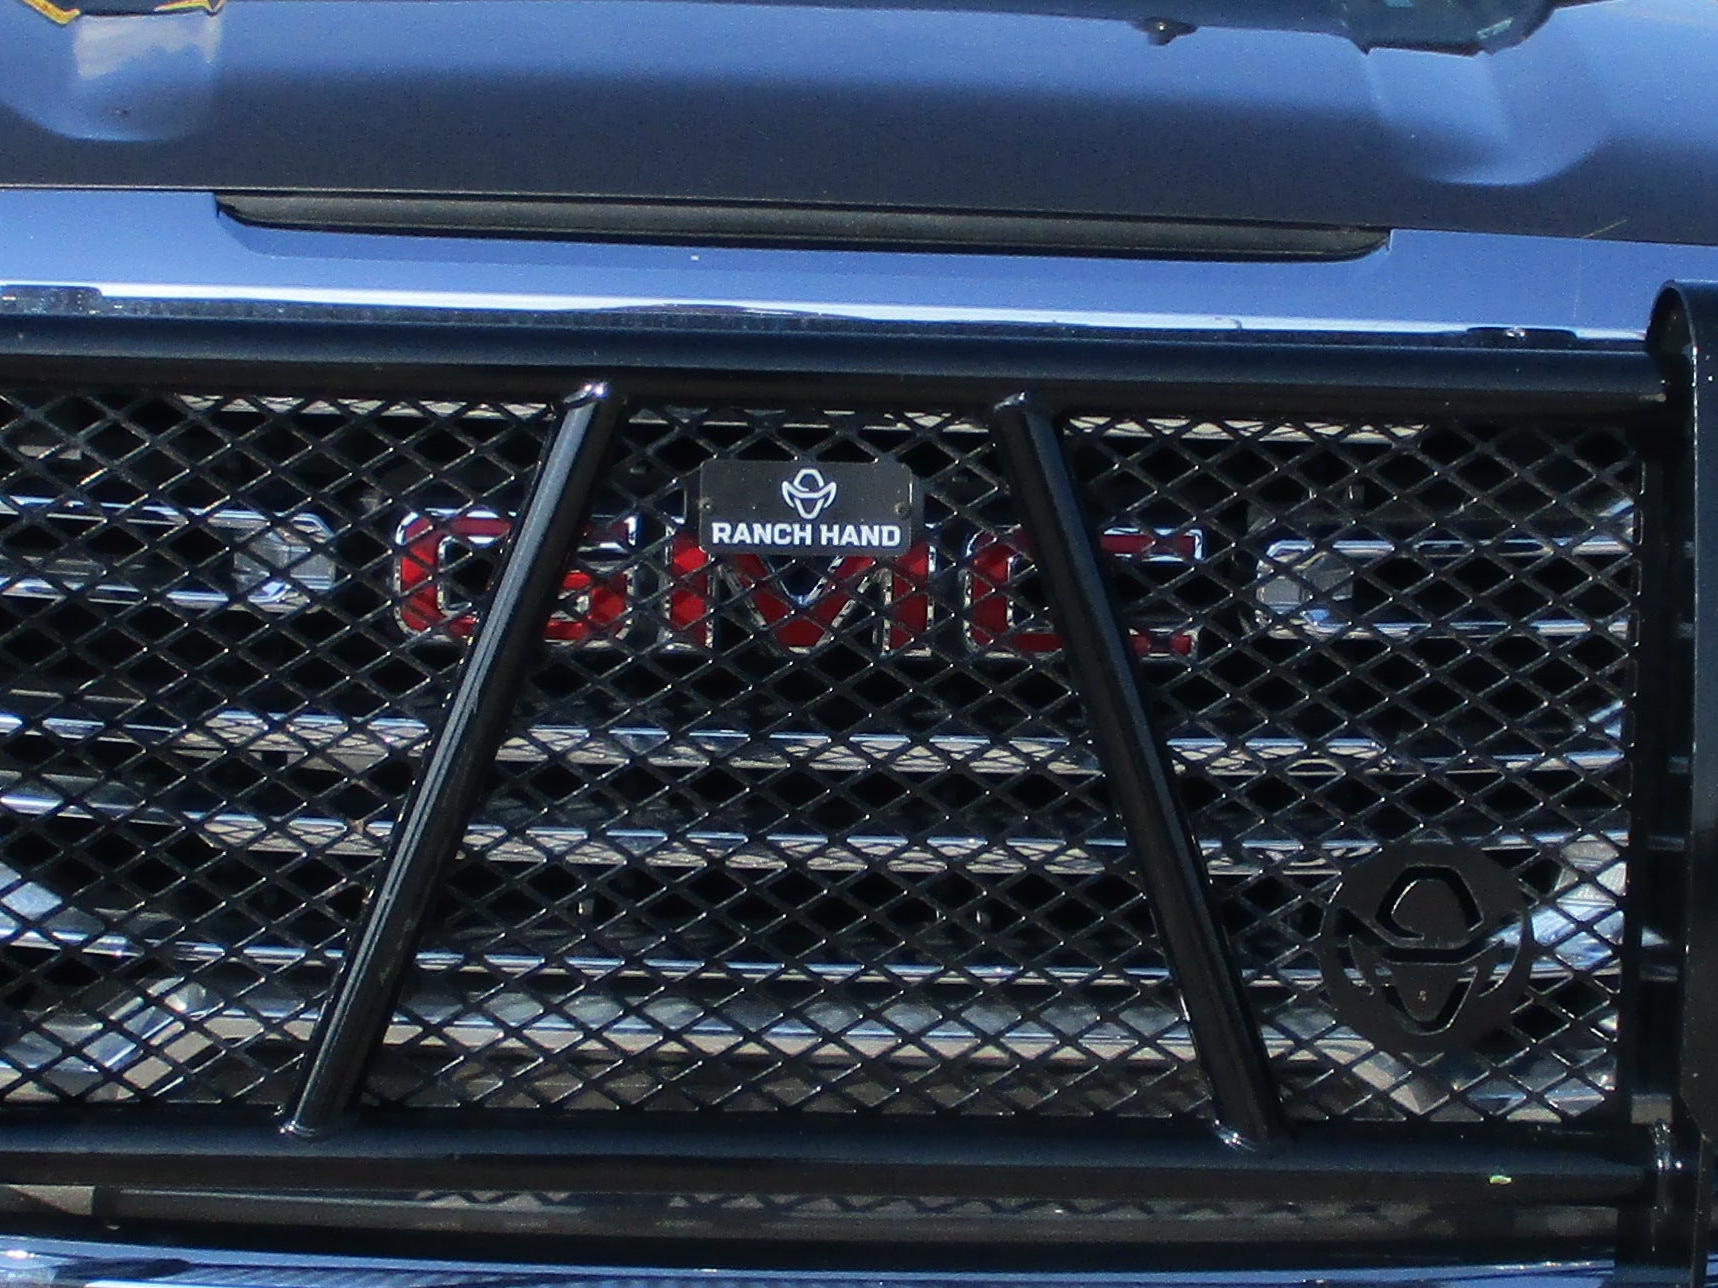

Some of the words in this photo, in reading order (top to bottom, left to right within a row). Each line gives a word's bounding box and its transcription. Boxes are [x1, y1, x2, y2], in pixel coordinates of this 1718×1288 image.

[711, 521, 813, 546] RANCH
[819, 523, 902, 547] HAND
[394, 508, 1205, 658] GMC
